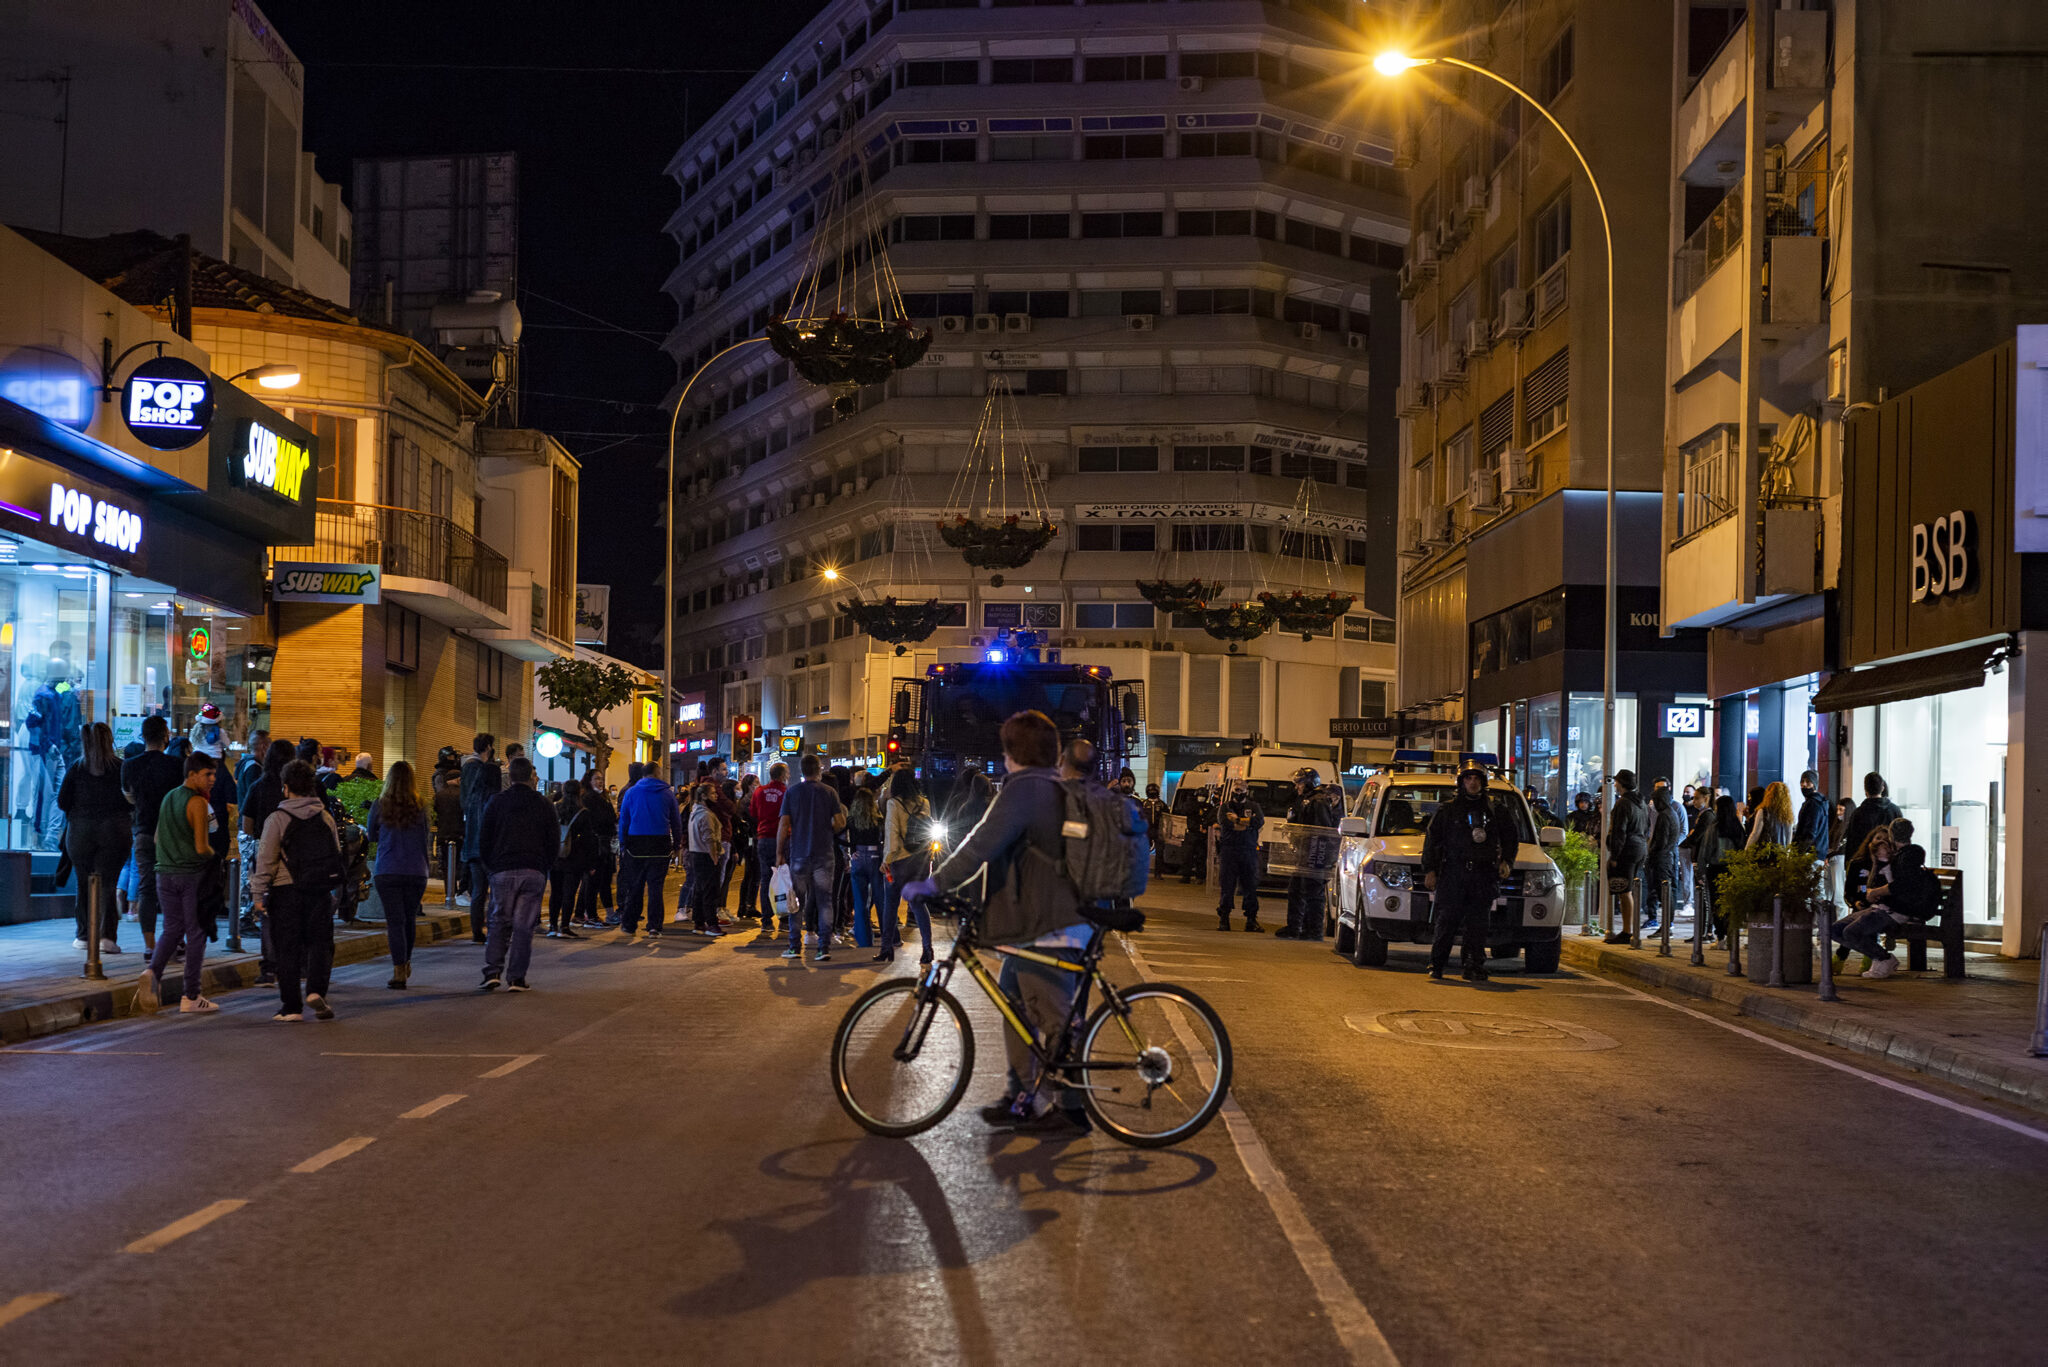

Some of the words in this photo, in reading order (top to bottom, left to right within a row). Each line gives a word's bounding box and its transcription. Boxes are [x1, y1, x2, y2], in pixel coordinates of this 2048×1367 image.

[130, 380, 205, 421] POP
[139, 407, 194, 424] SHOP
[243, 421, 310, 501] SUBWAY
[49, 483, 92, 536] POP
[93, 500, 143, 553] SHOP
[1117, 510, 1244, 518] ΓΑΛΑΝΟΣ
[1911, 510, 1968, 604] BSB
[276, 569, 376, 596] SUBWAY
[1344, 623, 1367, 633] Deloitte
[1332, 722, 1360, 732] BERTO
[1362, 722, 1387, 731] LUCCI
[1316, 840, 1328, 865] POLICE
